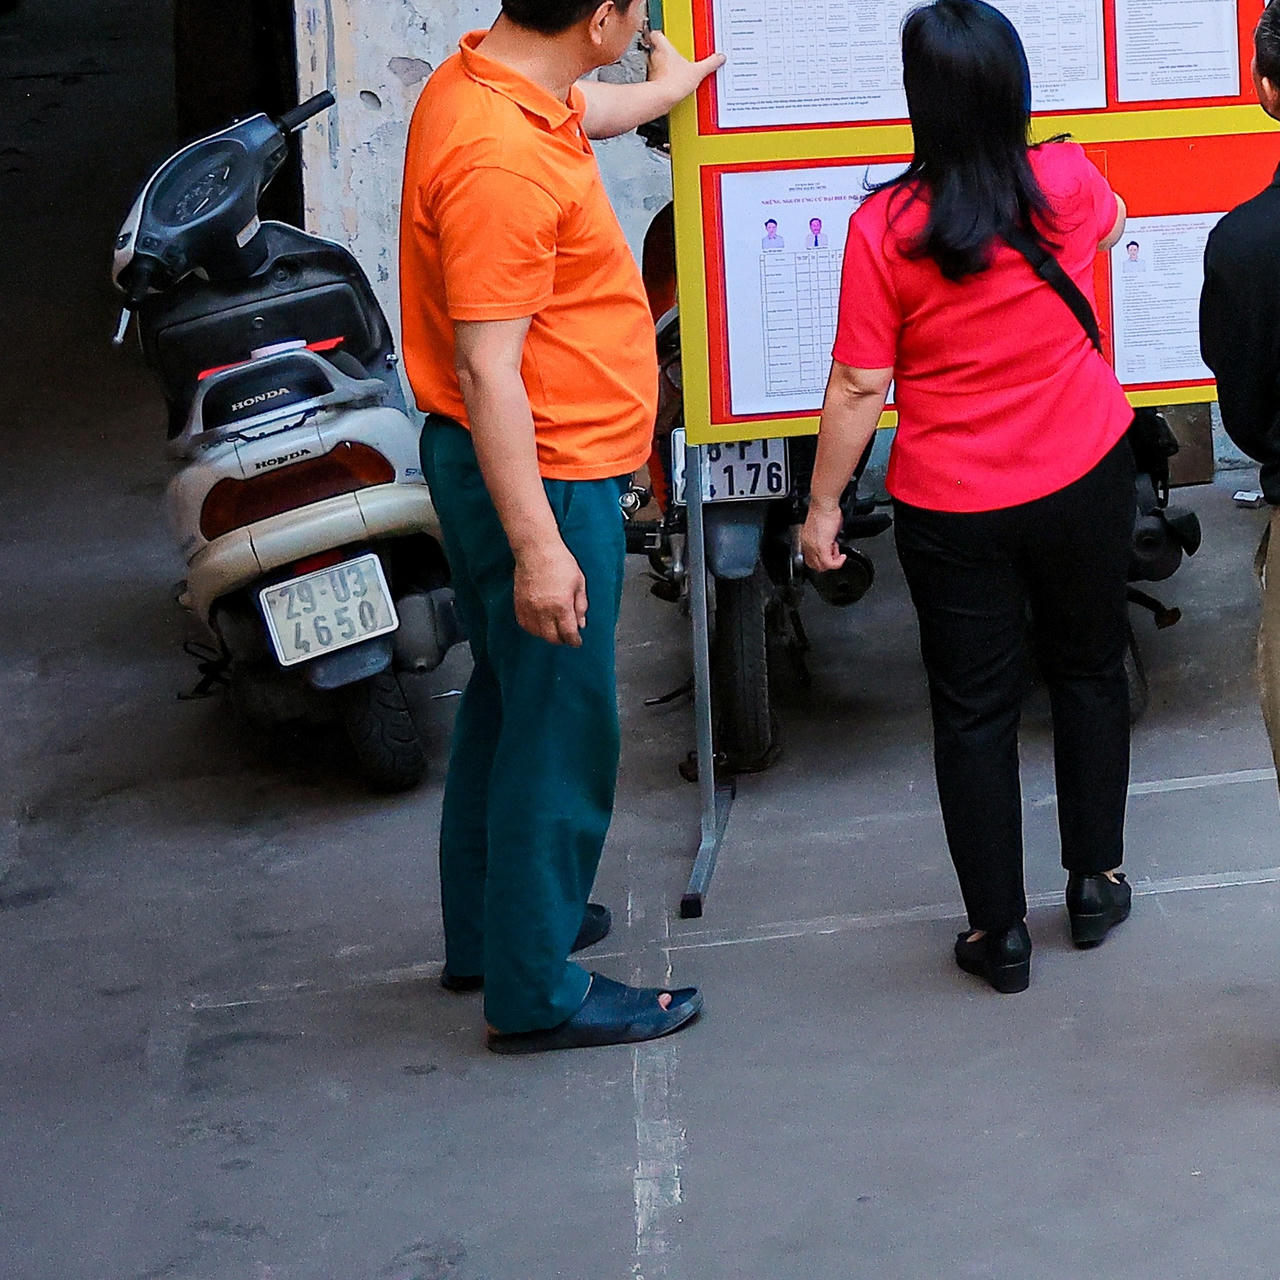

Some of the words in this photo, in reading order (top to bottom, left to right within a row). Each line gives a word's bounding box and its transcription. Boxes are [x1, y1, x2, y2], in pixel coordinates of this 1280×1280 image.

[232, 387, 291, 411] HONDA
[255, 448, 311, 469] HONDA
[711, 462, 782, 497] 1.76
[294, 600, 378, 653] 4650
